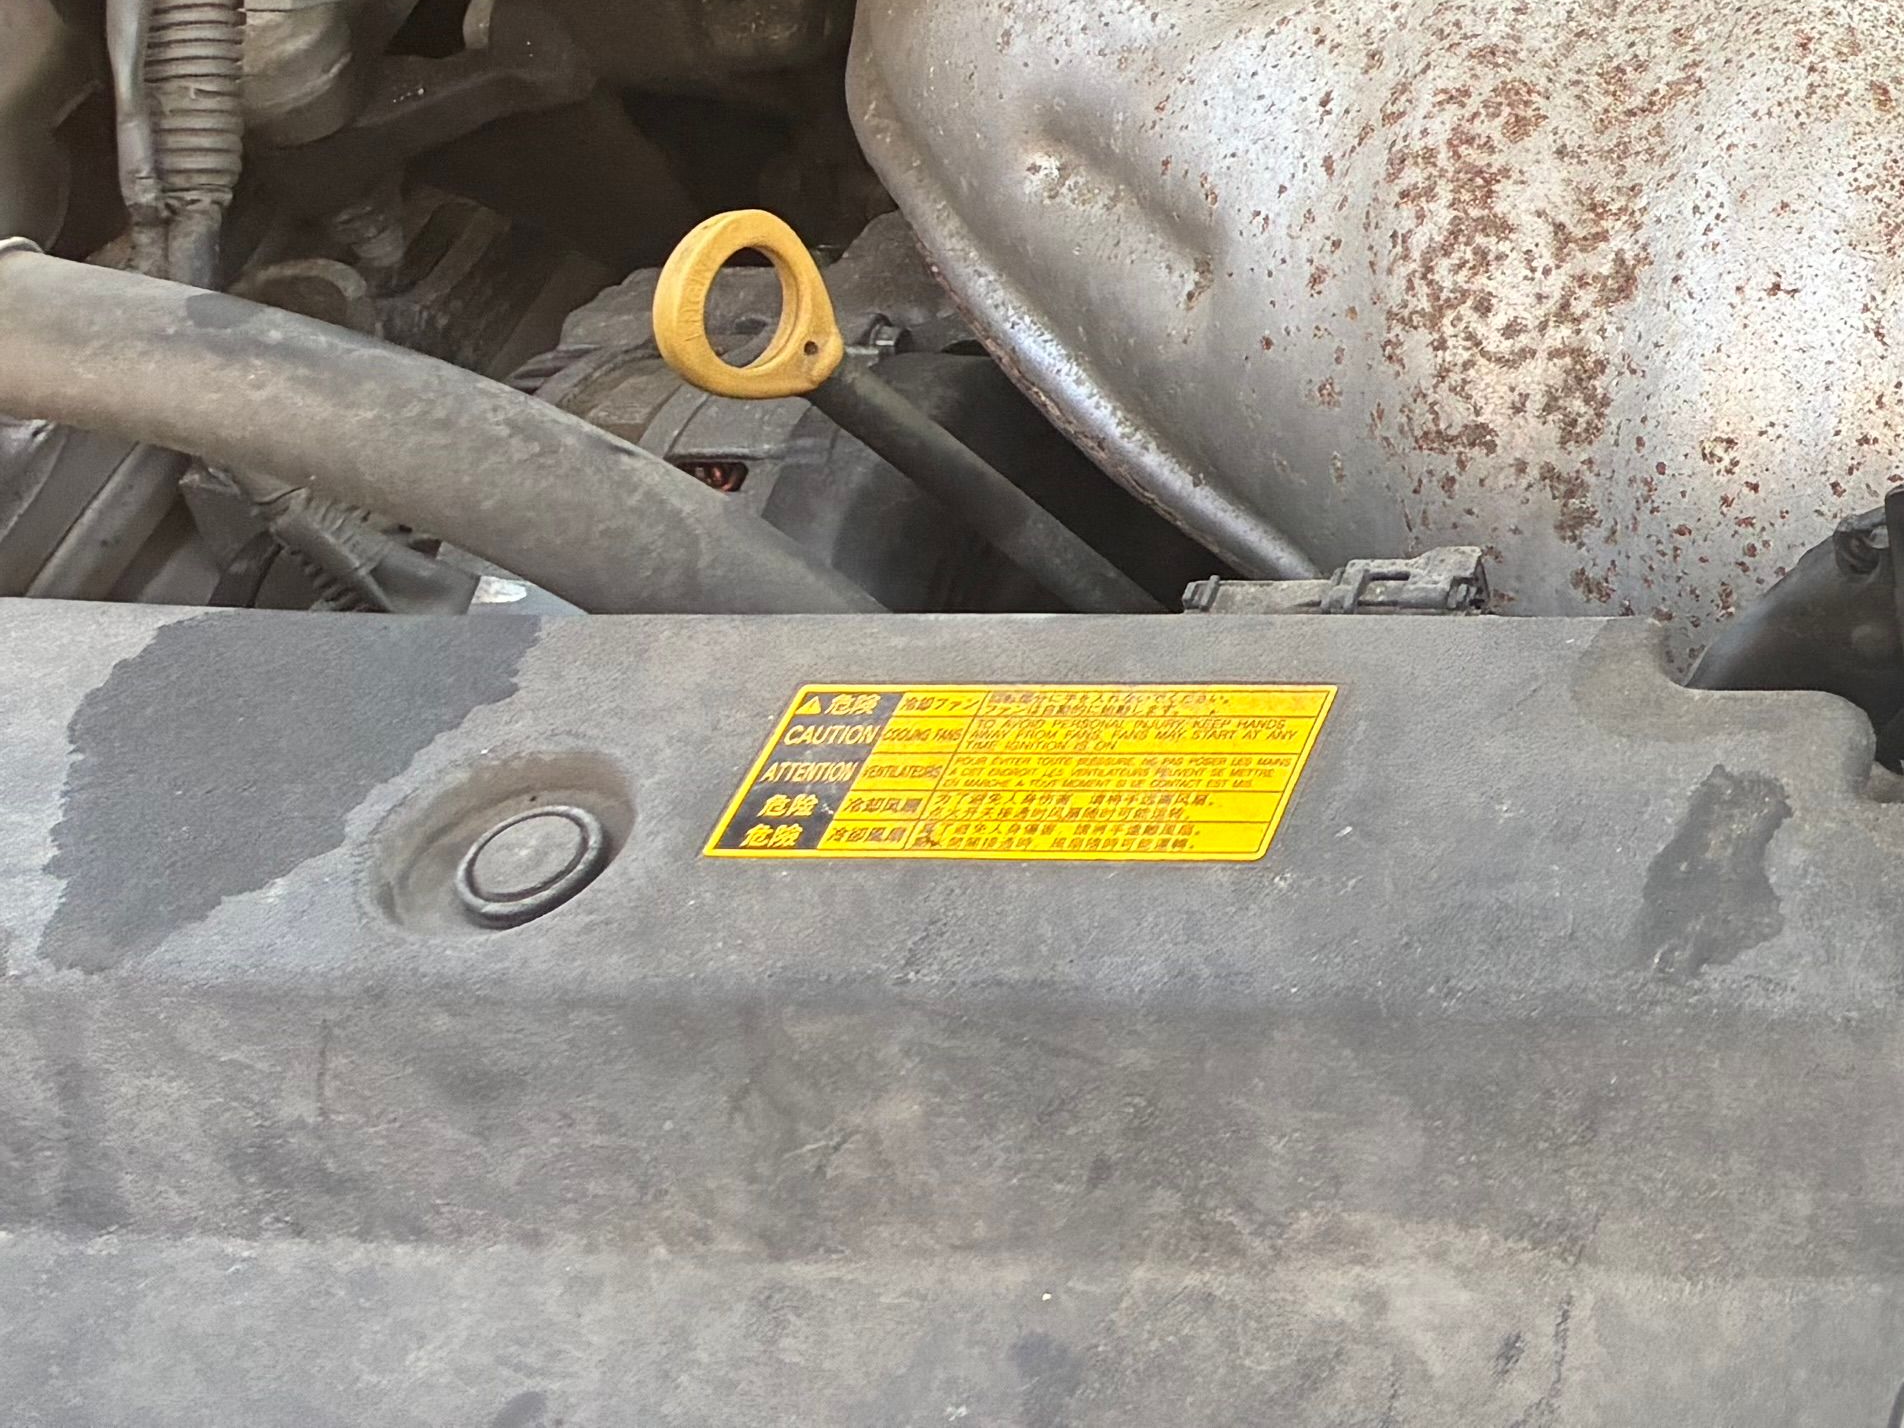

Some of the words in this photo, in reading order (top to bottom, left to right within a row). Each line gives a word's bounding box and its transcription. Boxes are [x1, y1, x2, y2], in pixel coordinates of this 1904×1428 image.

[978, 719, 995, 728] TO
[1002, 719, 1045, 728] AVOID
[1052, 719, 1124, 728] PERSONAL
[1192, 719, 1231, 729] KEEP
[1237, 719, 1285, 729] HANDS
[783, 725, 880, 745] CAUTION
[1016, 729, 1058, 739] FROM
[1191, 730, 1235, 739] START
[1242, 730, 1260, 739] AT
[1266, 730, 1297, 739] ANY
[759, 761, 858, 782] ATTENTION
